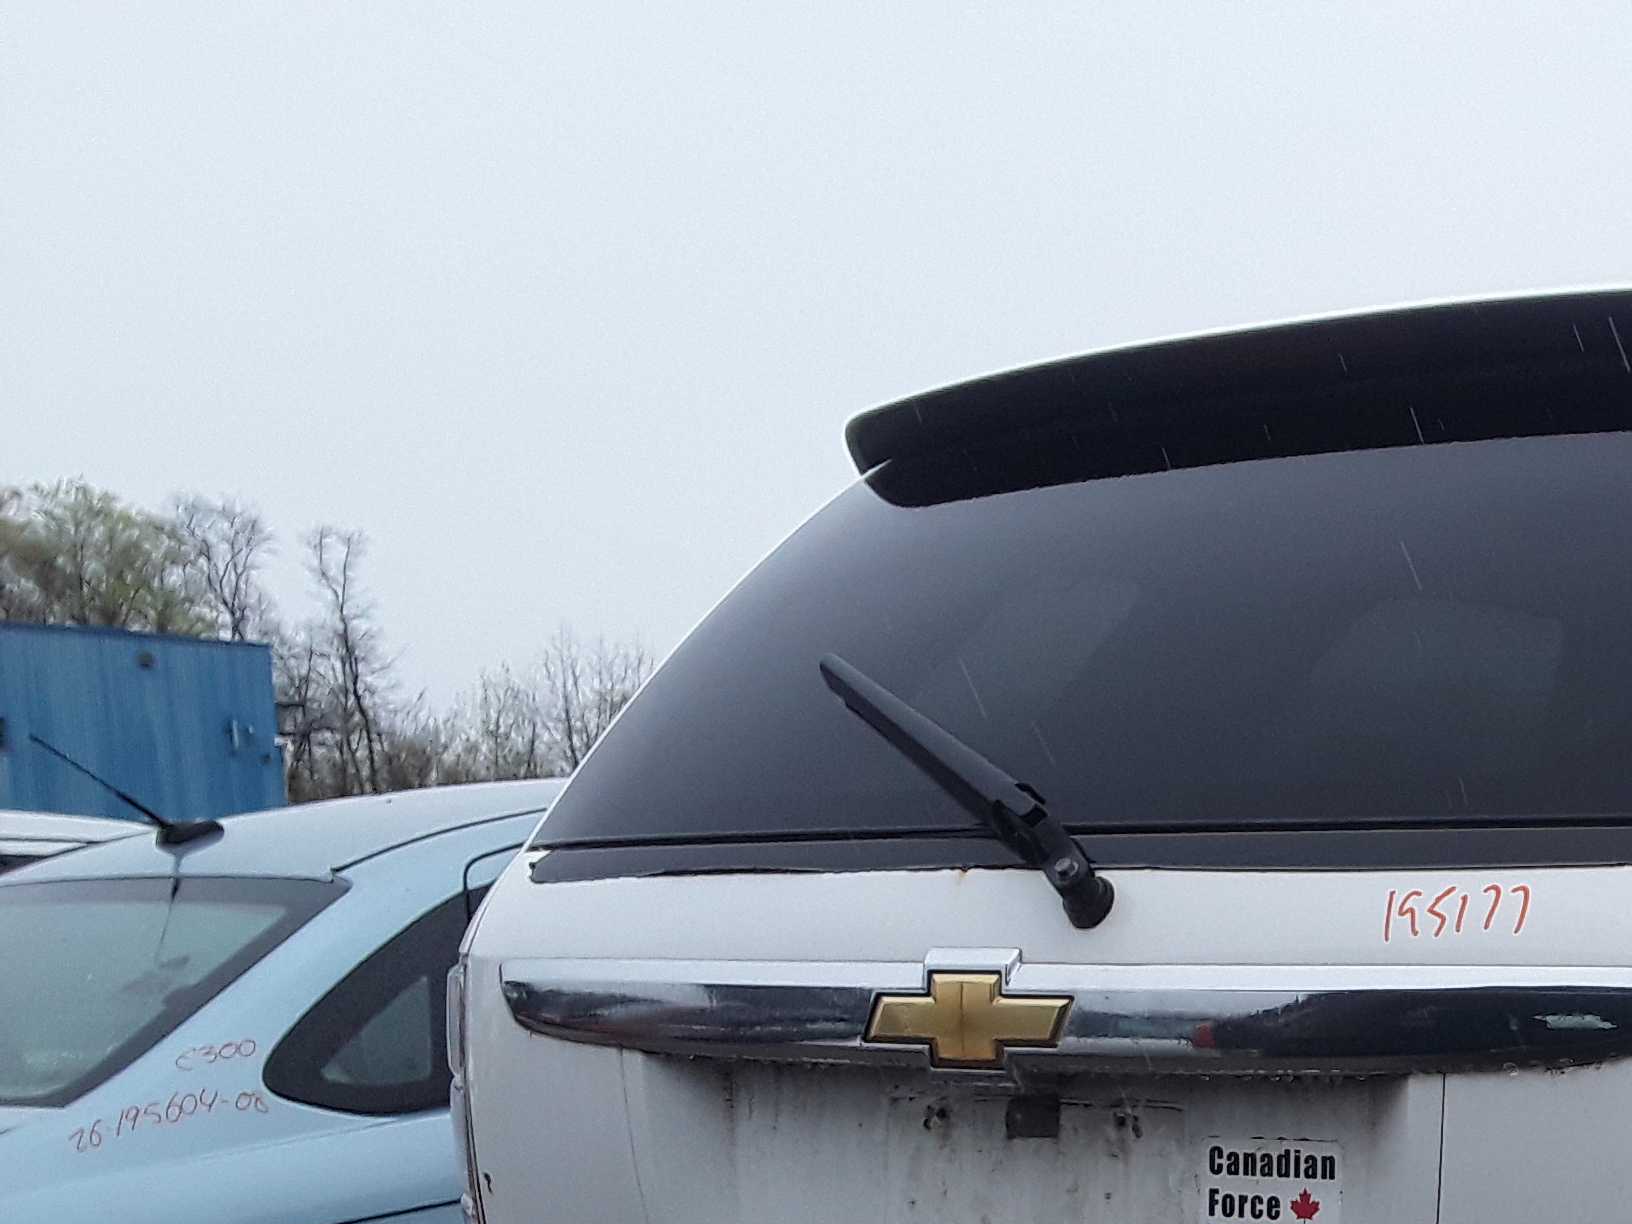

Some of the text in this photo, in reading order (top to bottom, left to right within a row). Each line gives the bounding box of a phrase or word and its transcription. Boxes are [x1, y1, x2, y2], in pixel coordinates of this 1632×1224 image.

[1383, 882, 1532, 943] 195177
[1207, 1145, 1337, 1181] Canadian
[1207, 1187, 1282, 1221] Force
